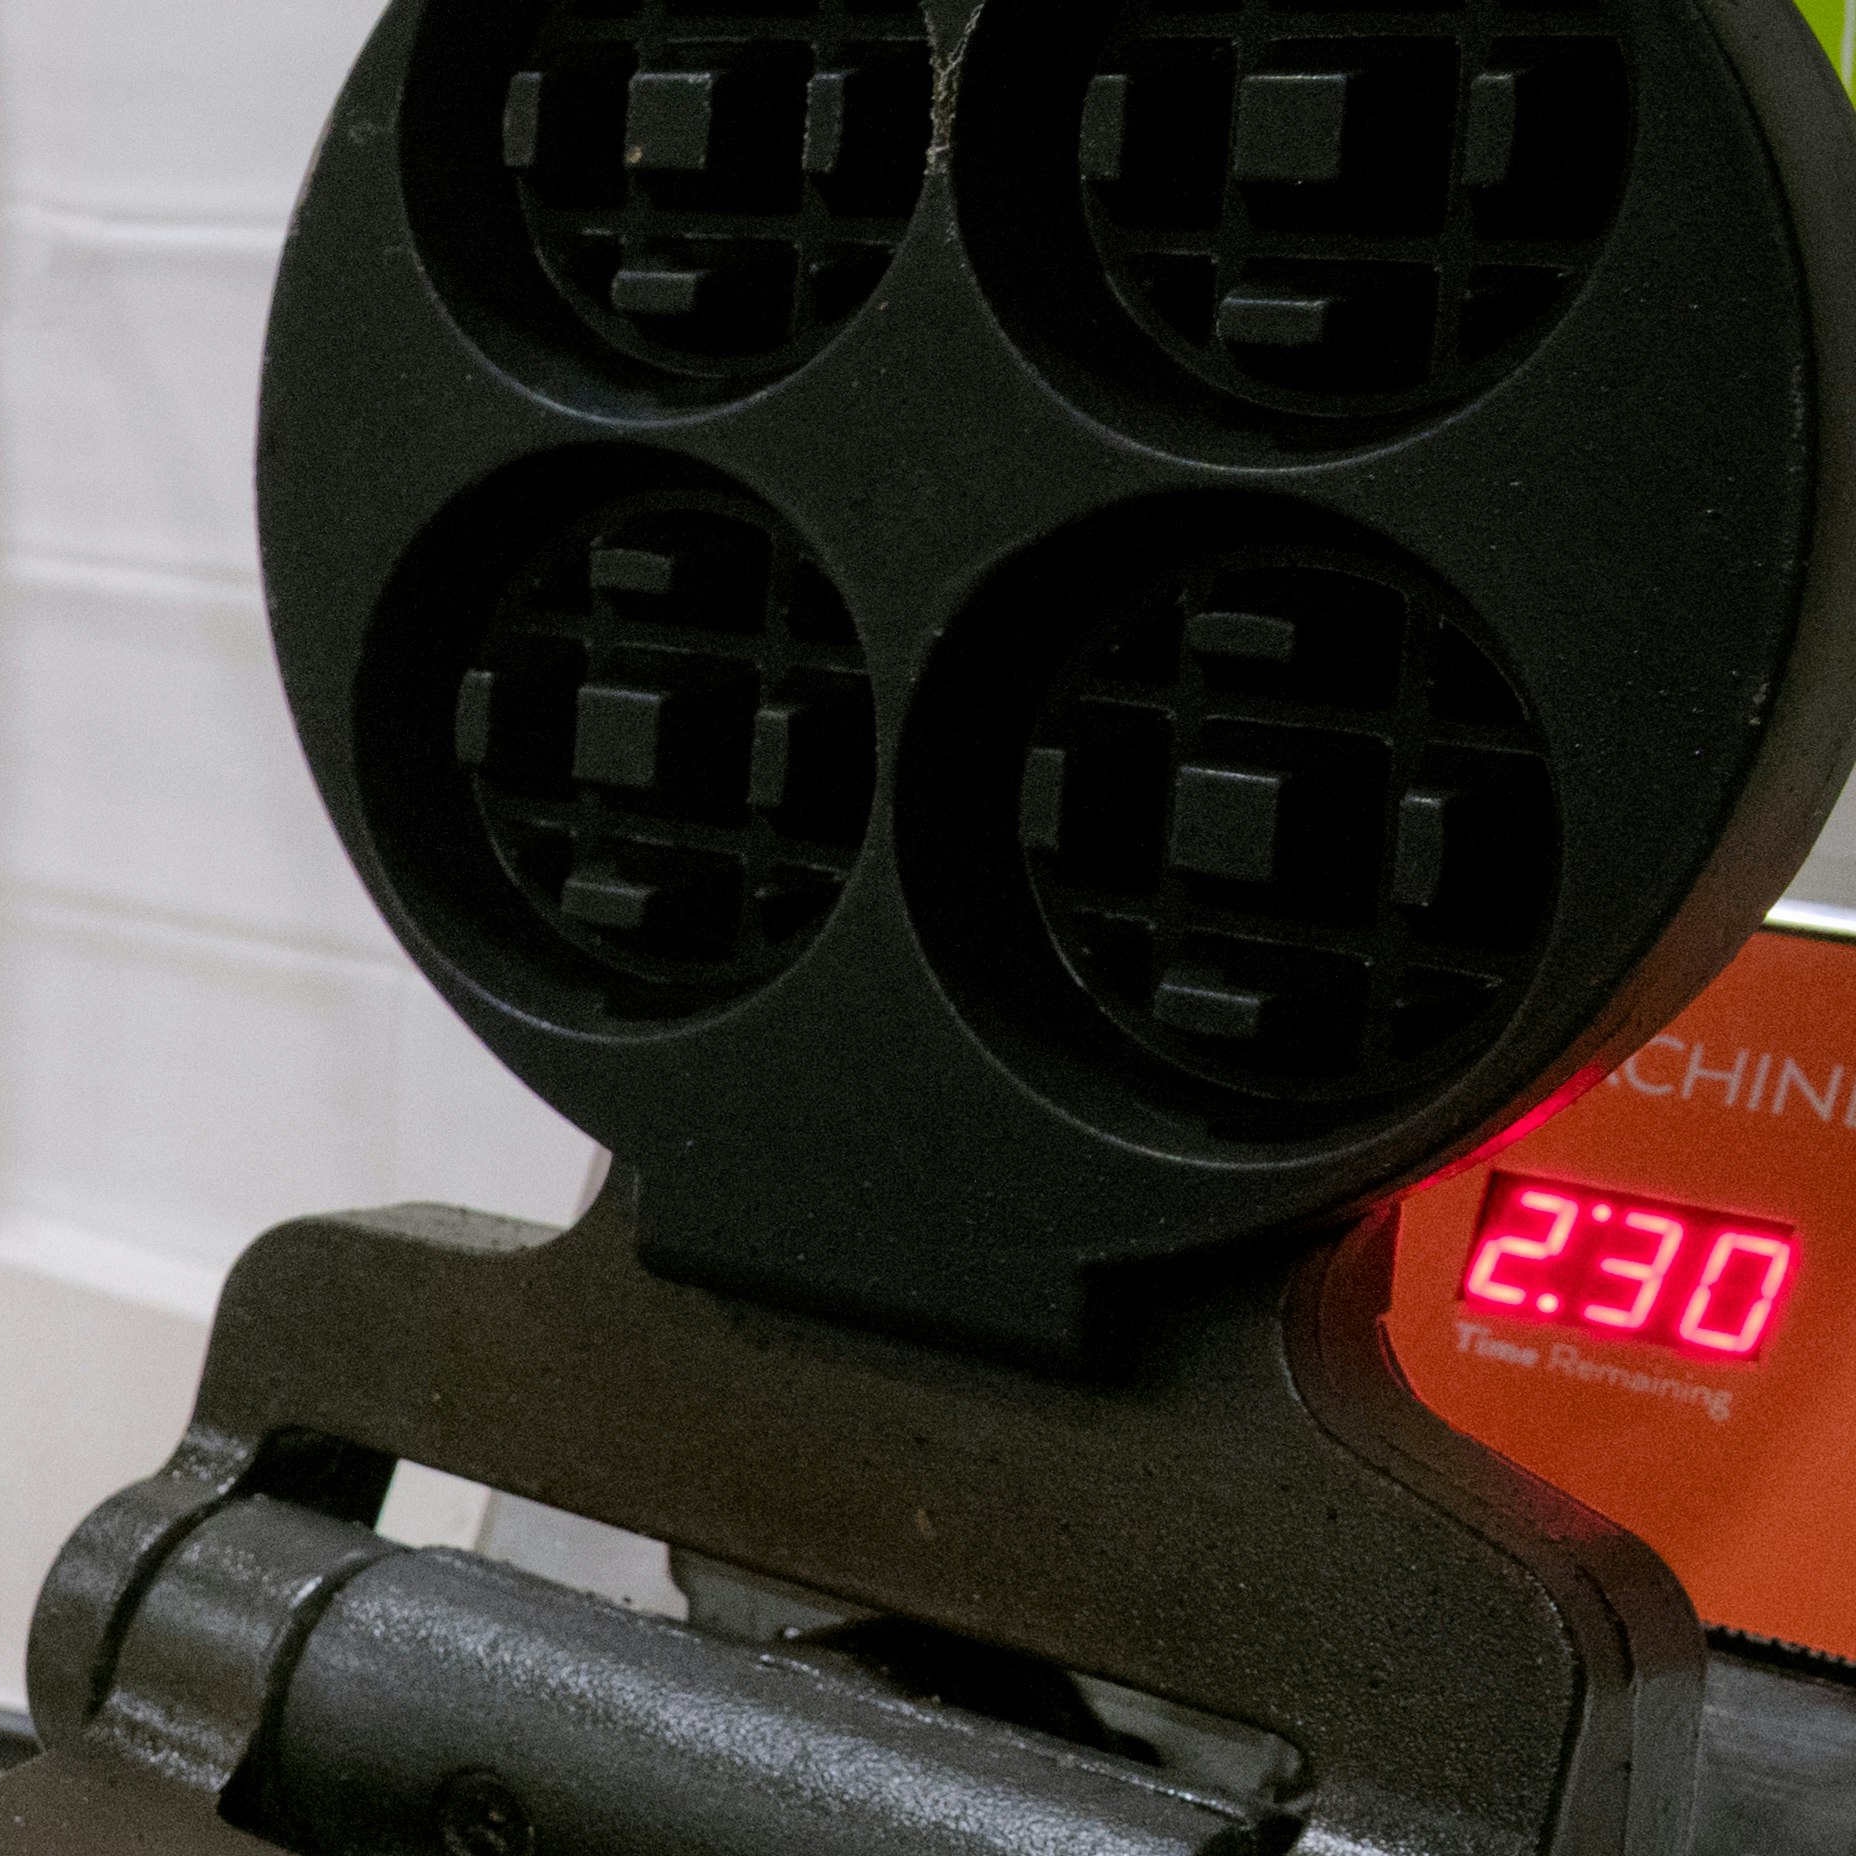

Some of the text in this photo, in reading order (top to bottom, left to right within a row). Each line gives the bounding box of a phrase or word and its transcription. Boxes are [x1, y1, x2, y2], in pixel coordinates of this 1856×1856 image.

[1607, 1034, 1856, 1130] CHIN
[1466, 1189, 1791, 1352] 2:30
[1457, 1321, 1734, 1422] Time Remaining
